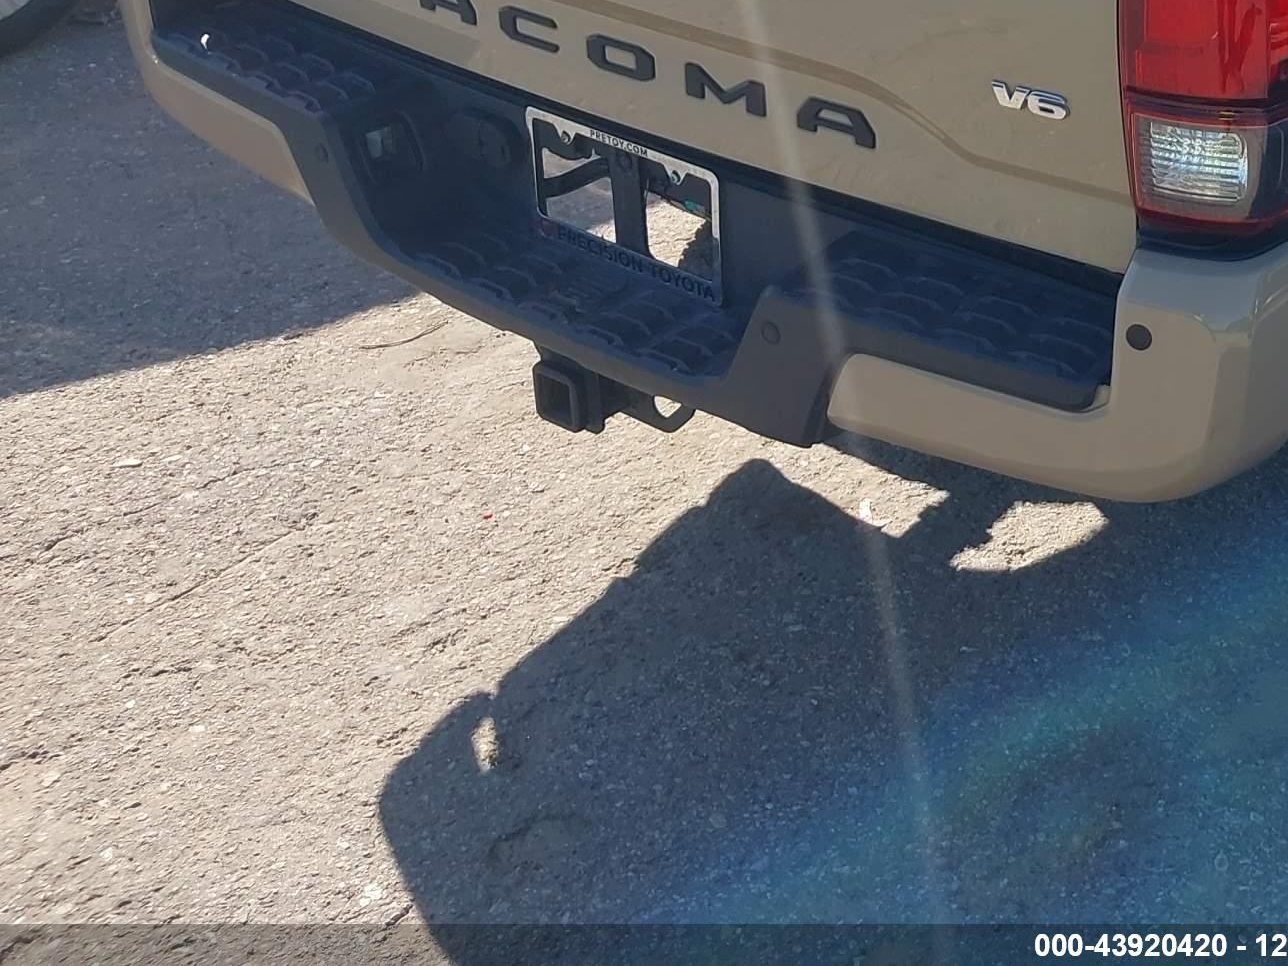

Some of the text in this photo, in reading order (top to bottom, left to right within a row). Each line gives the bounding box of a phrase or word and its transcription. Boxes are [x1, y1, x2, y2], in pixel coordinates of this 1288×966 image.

[991, 80, 1070, 120] V6
[589, 129, 649, 157] PRETOY.COM
[557, 229, 716, 301] PRECISION TOYOTA
